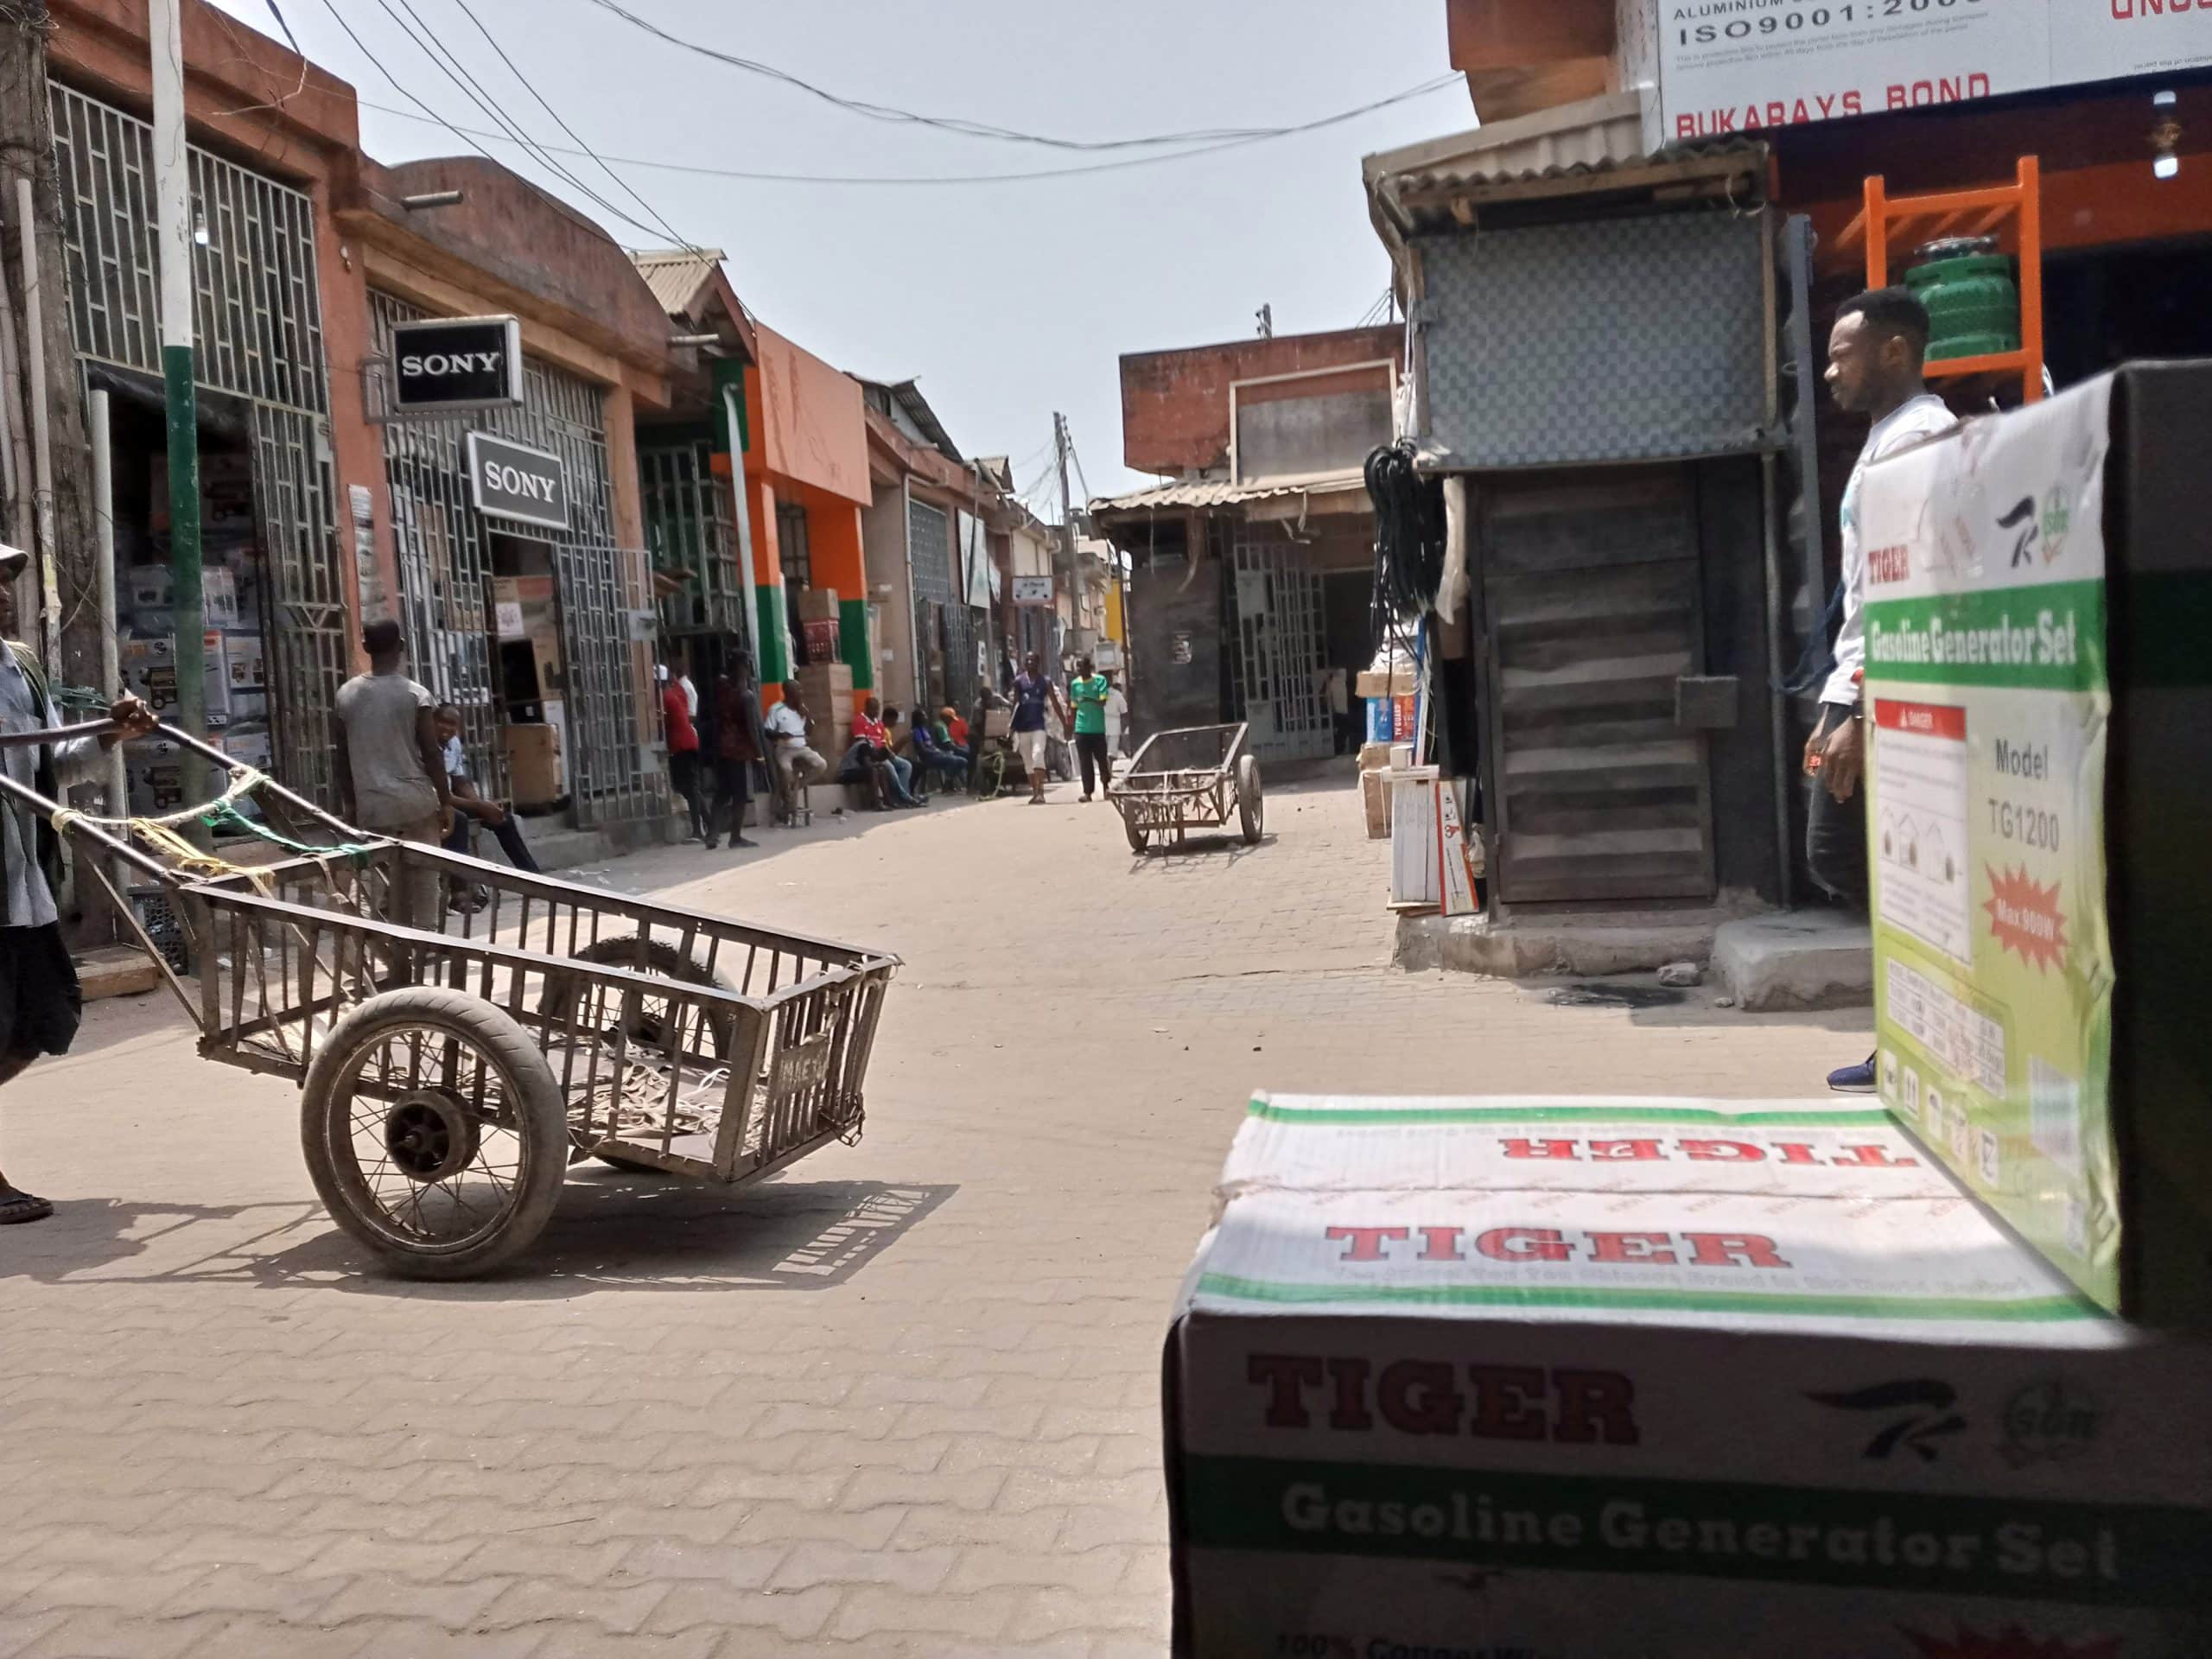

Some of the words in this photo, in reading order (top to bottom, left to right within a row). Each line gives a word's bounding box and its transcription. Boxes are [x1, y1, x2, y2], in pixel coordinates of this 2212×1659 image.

[402, 352, 499, 377] SONY
[484, 460, 556, 503] SONY
[1868, 544, 1910, 586] TIGER
[1871, 620, 1929, 663] Gasoline
[1929, 613, 2037, 664] Generator
[2037, 609, 2077, 665] Set
[1995, 738, 2049, 781] Model
[1988, 798, 2060, 853] TG1200
[1997, 898, 2019, 927] Max
[1498, 1138, 1921, 1166] TIGER
[1325, 1226, 1795, 1268] TIGER
[1247, 1354, 1640, 1446] TIGER
[1281, 1483, 1582, 1551] Gasoline
[1599, 1502, 1981, 1566] Generator
[1994, 1519, 2120, 1582] Set
